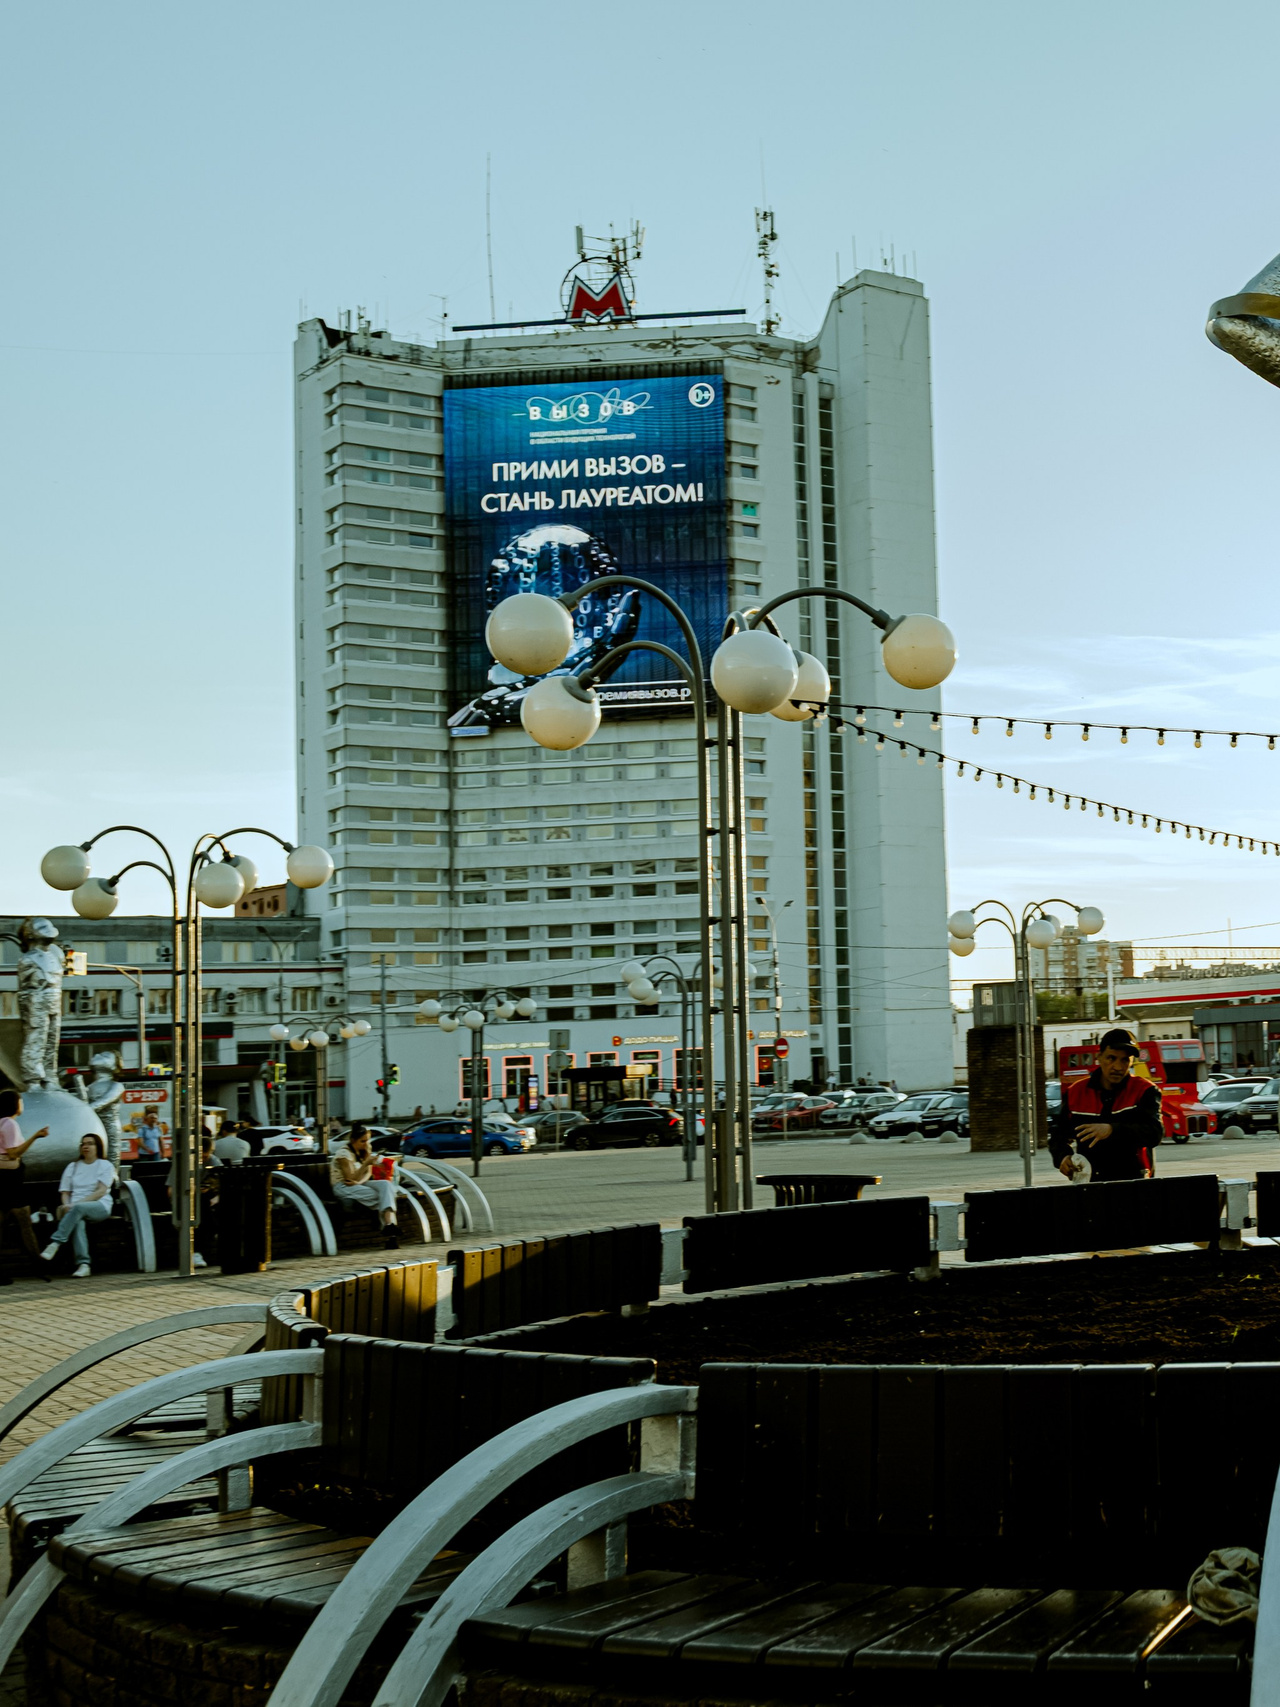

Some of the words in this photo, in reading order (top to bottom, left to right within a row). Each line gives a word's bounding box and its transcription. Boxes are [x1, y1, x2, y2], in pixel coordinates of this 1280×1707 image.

[492, 458, 578, 482] ПРИМИ
[585, 454, 666, 478] ВЫЗОВ
[480, 491, 555, 514] СТАНЬ
[558, 483, 704, 509] ЛАУРЕАТОМ!
